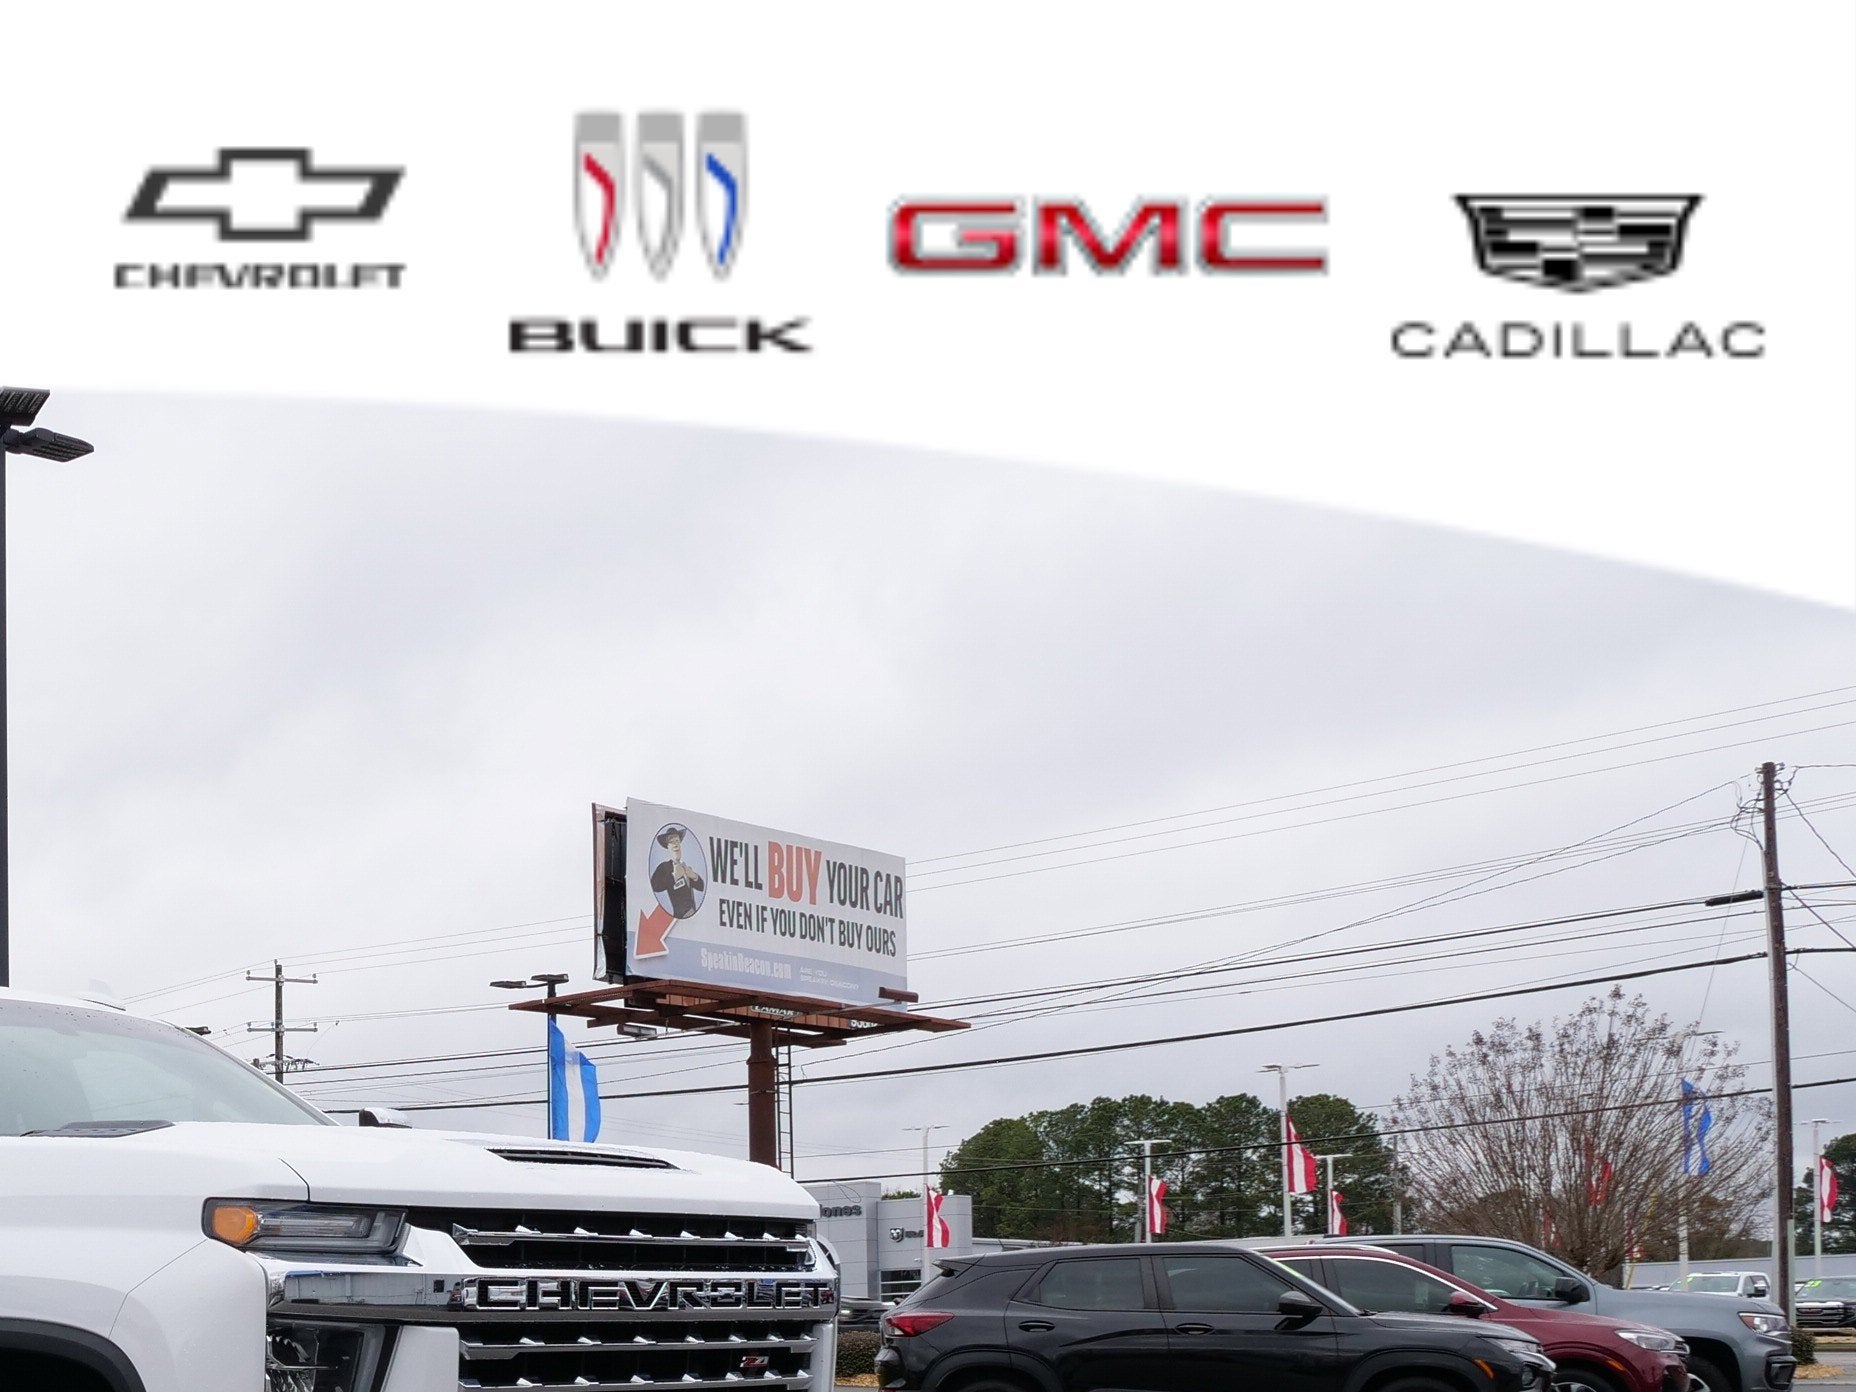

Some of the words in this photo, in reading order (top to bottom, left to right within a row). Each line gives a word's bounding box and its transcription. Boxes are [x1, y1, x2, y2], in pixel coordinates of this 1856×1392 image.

[709, 836, 763, 890] WE'LL
[768, 841, 822, 905] BUY
[826, 860, 870, 911] YOUR
[874, 870, 904, 919] CAR
[719, 898, 753, 931] EVEN
[756, 904, 768, 933] IF
[770, 907, 796, 937] YOU
[799, 912, 835, 944] DON'T
[838, 920, 863, 949] BUY
[866, 925, 896, 957] OURS
[476, 1278, 830, 1310] CHEVROLET
